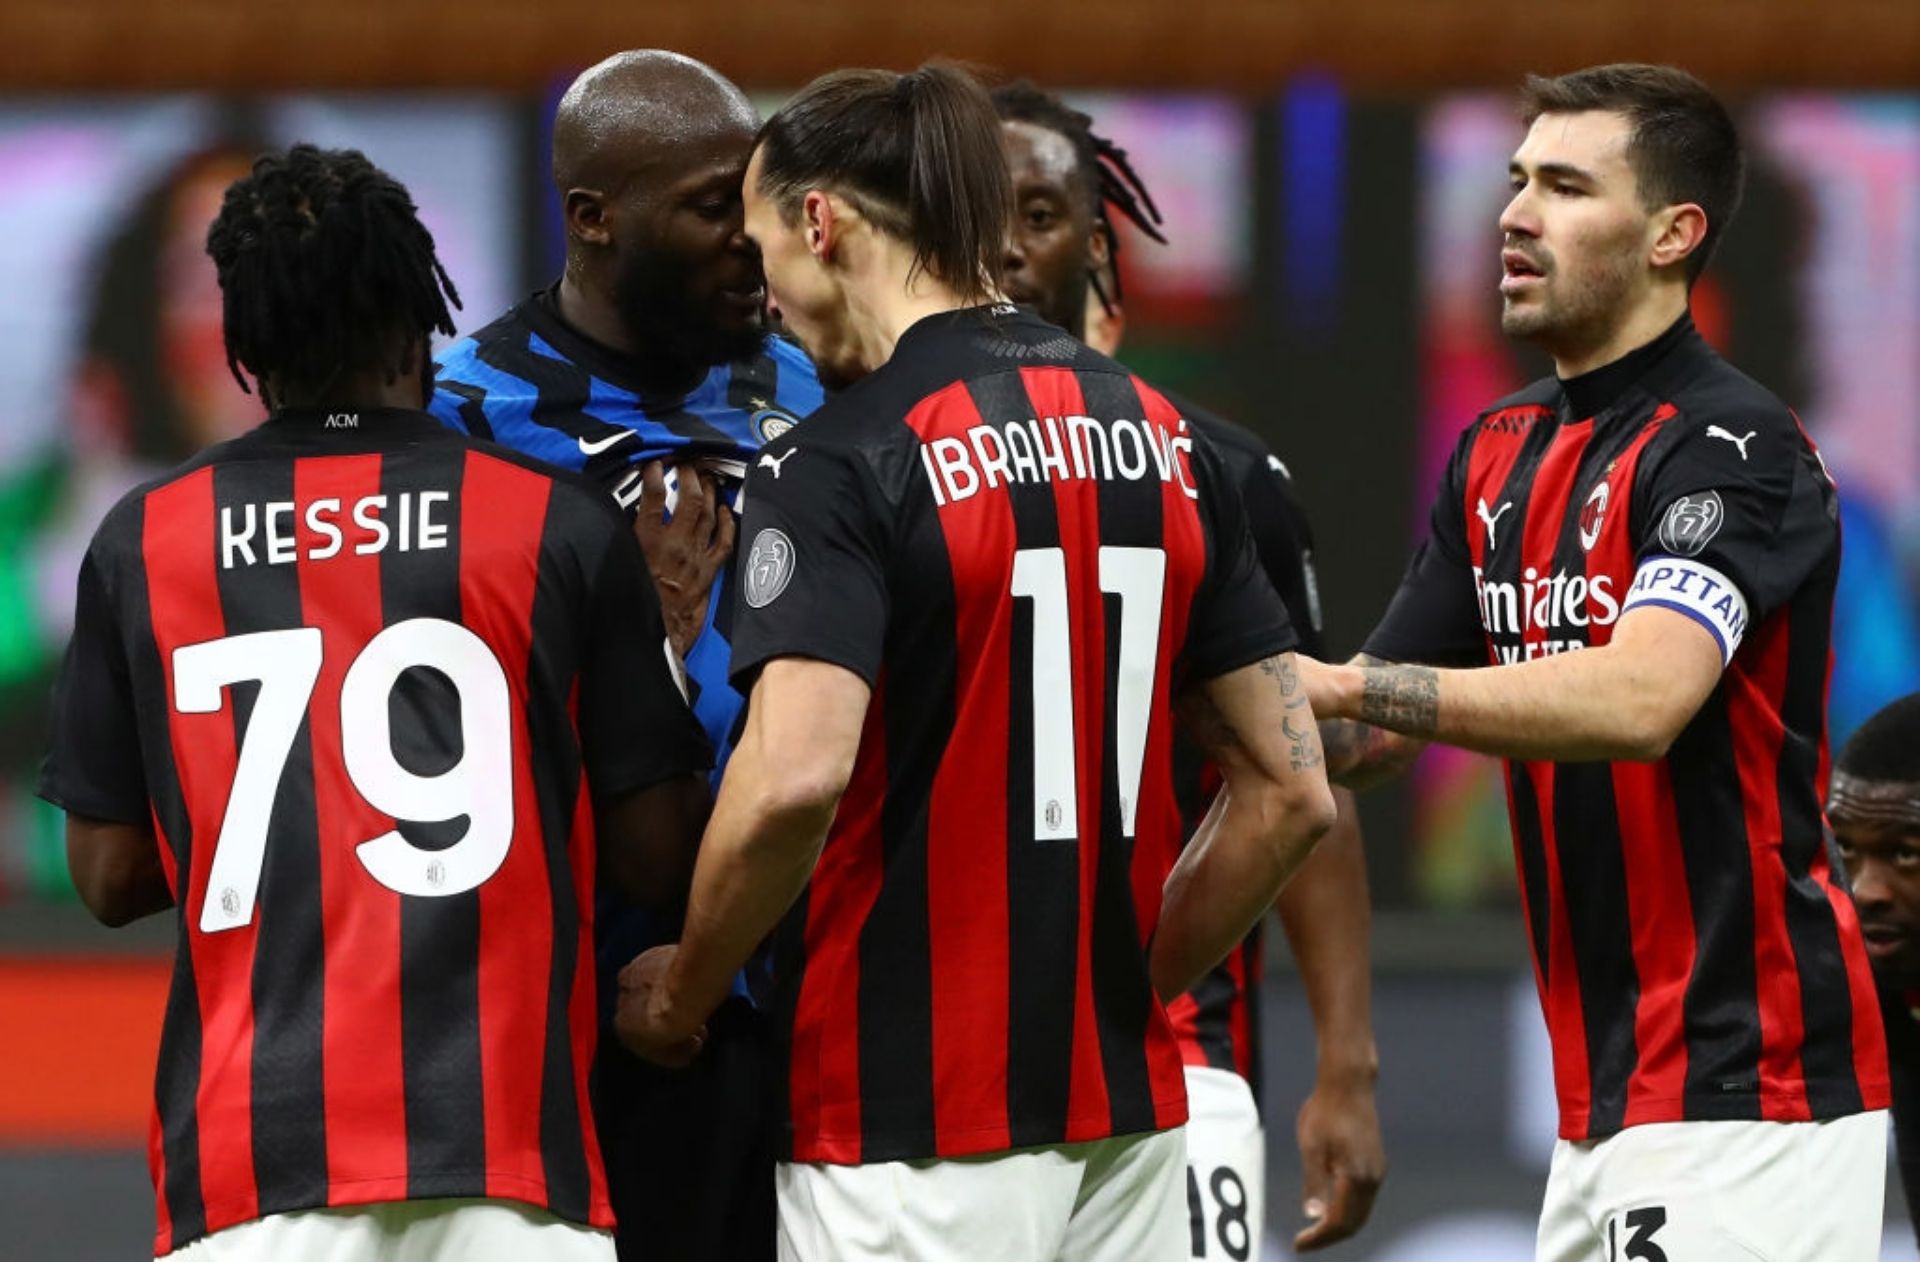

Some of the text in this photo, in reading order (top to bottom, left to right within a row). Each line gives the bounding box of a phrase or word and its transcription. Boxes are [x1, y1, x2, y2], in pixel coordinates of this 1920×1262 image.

[324, 413, 359, 428] ACM
[920, 415, 1199, 506] IBRAHMOVIĆ
[221, 491, 449, 569] KESSIE
[1681, 517, 1696, 535] 7
[760, 565, 769, 587] 7
[1472, 566, 1619, 632] Emiates
[1010, 547, 1166, 840] 11
[172, 617, 514, 932] 79
[1186, 1165, 1250, 1262] 18
